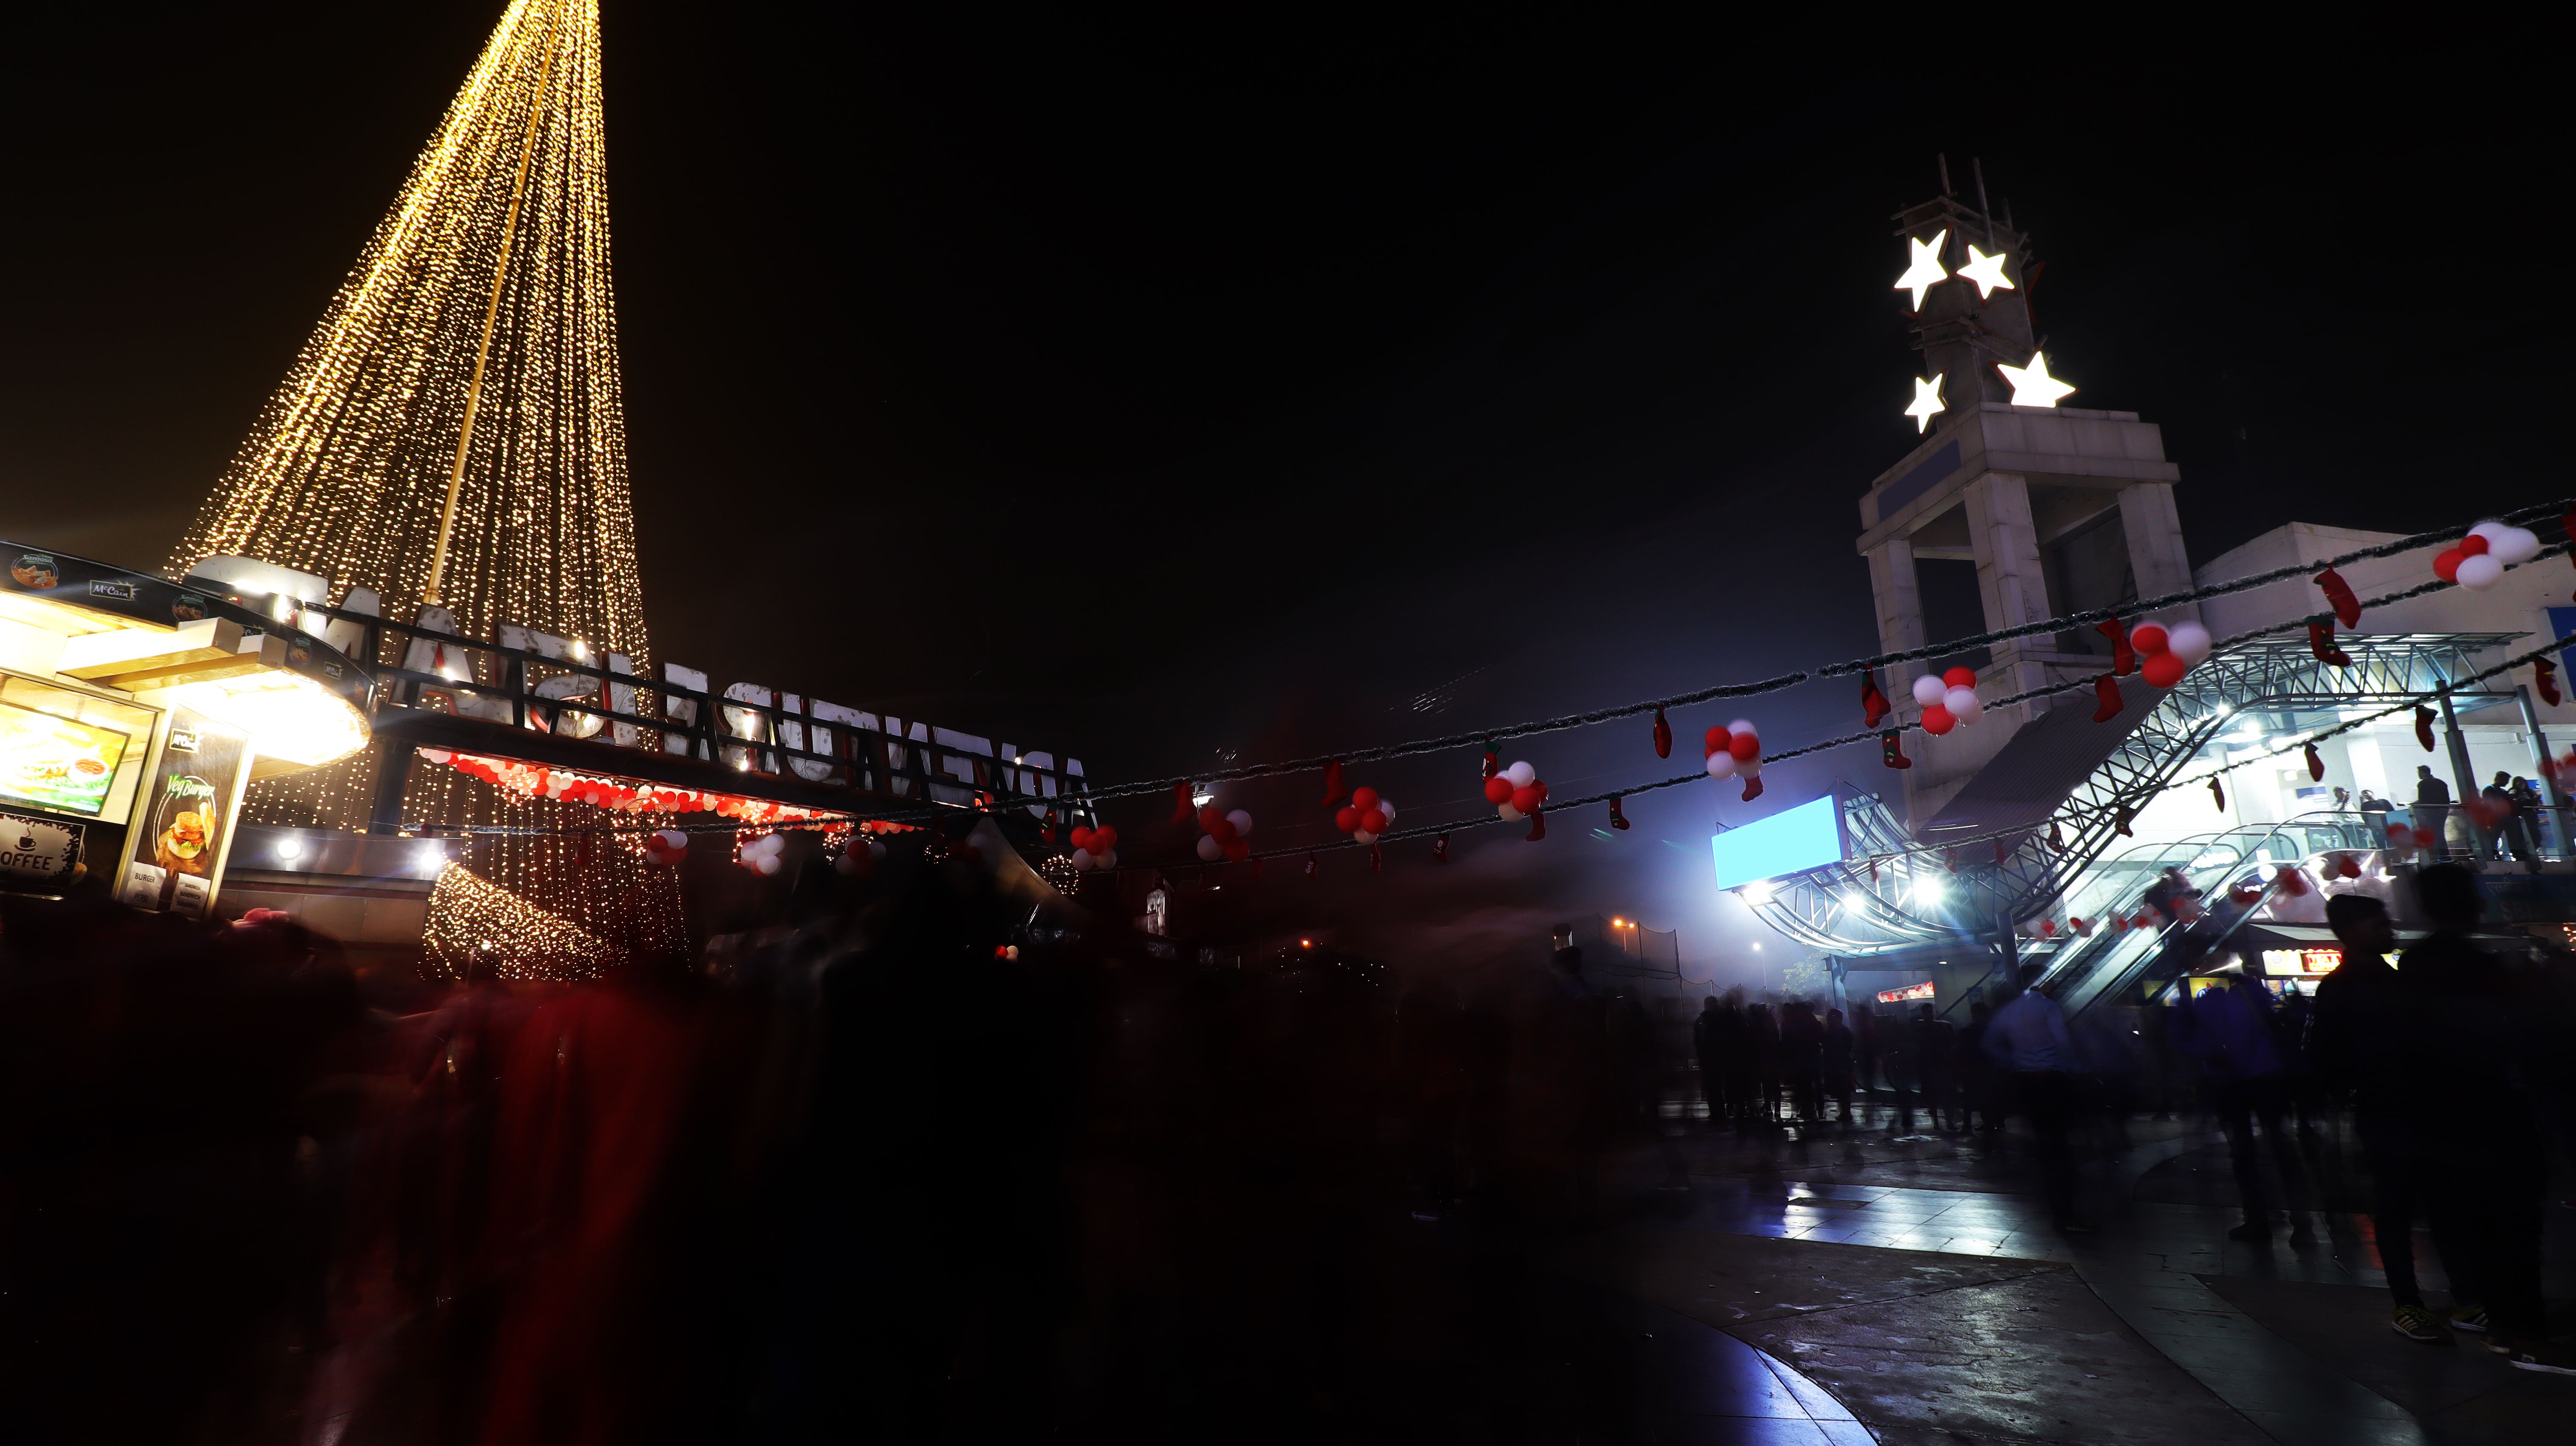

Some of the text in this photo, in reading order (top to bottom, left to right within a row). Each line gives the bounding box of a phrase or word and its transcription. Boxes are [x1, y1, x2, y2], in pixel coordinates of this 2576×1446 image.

[21, 554, 53, 564] Samosa
[92, 584, 130, 598] McCain
[166, 774, 216, 801] Veg Burger
[0, 850, 54, 871] OFFEE
[135, 873, 155, 883] BURGER
